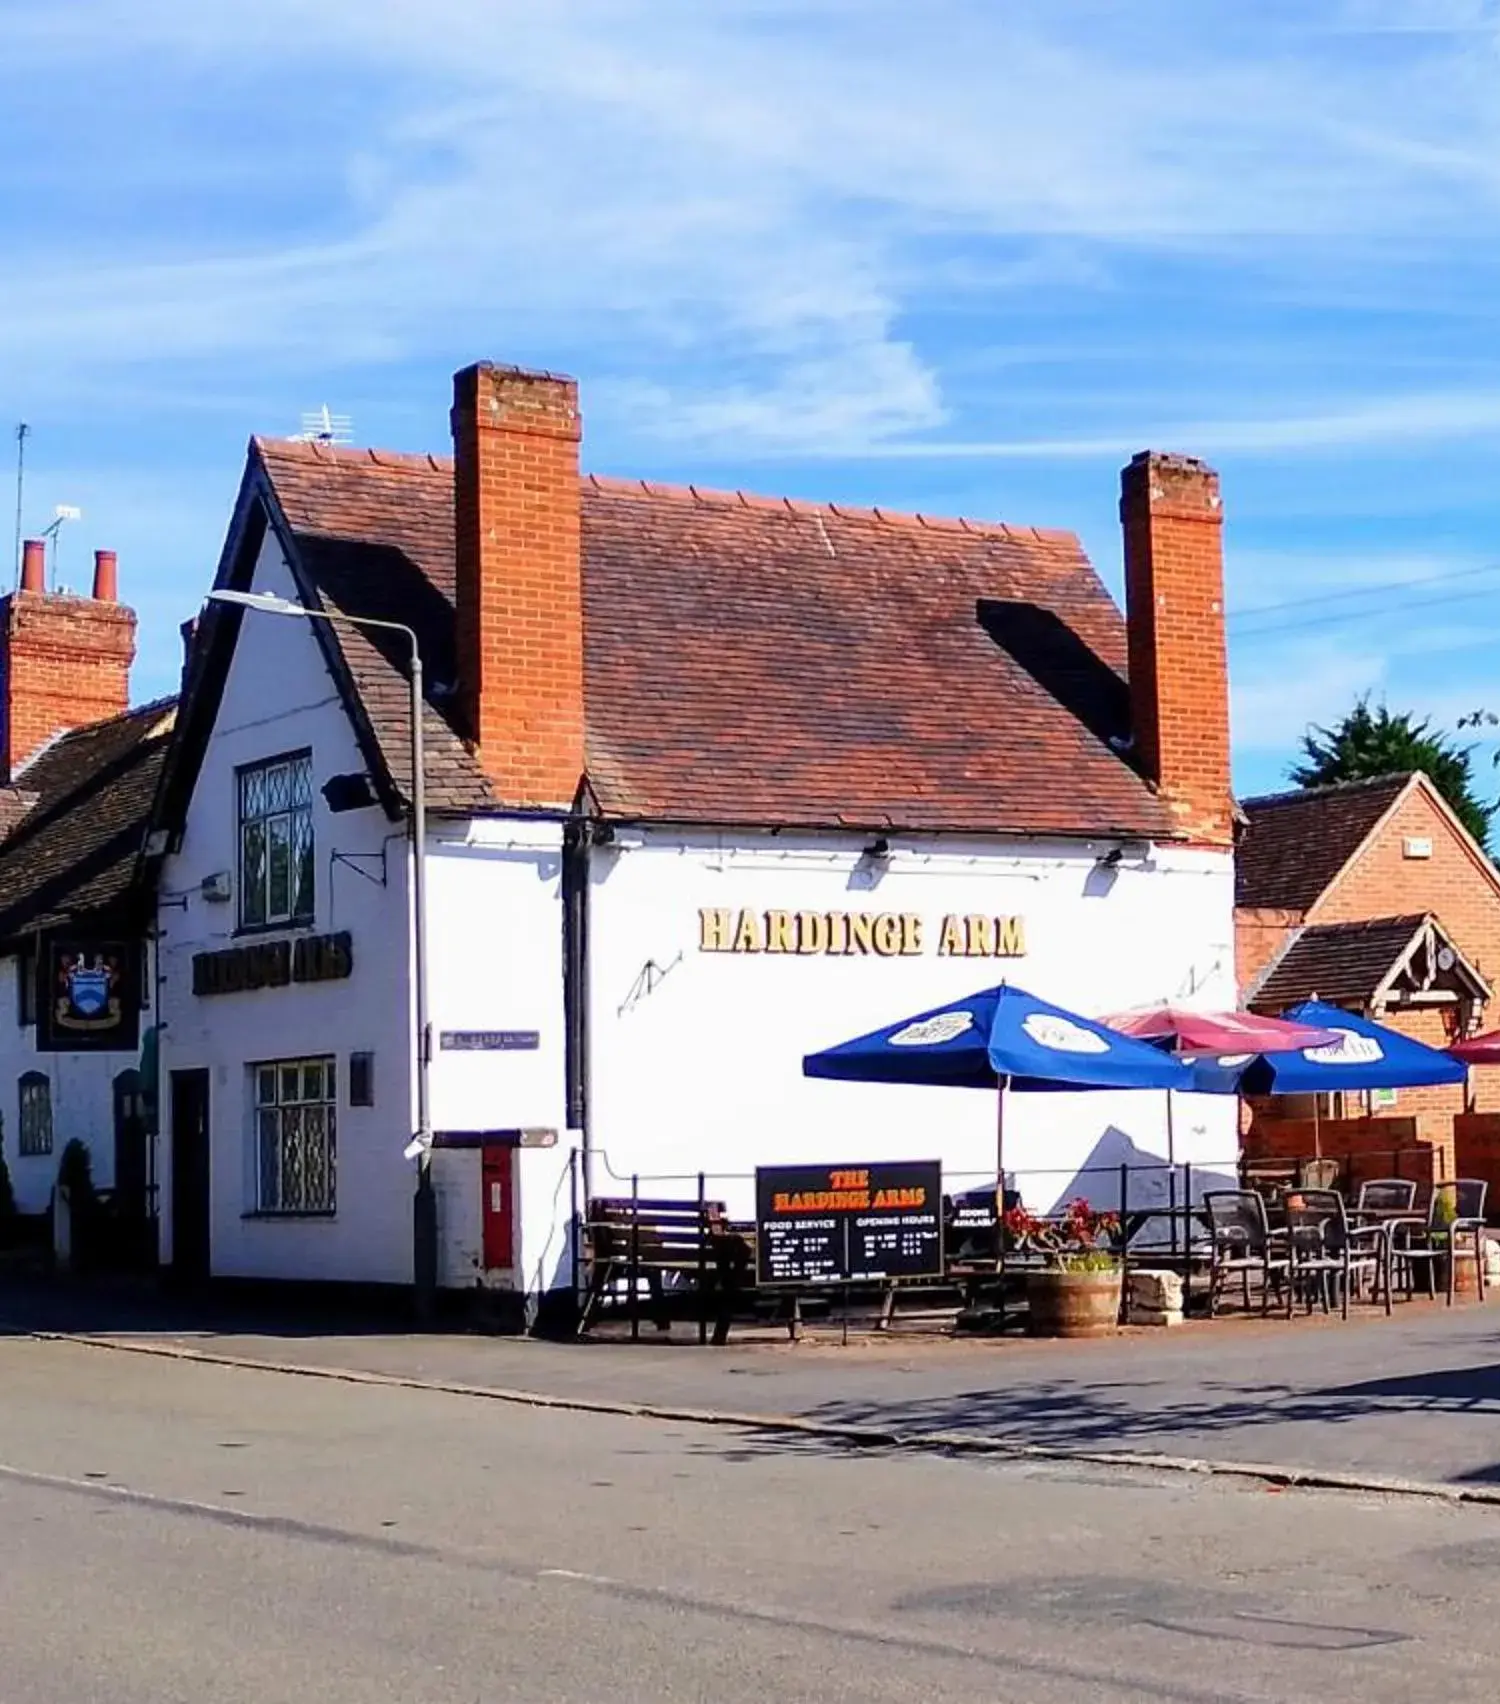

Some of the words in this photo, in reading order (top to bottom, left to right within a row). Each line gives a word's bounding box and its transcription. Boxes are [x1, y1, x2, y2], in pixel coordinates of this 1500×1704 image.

[698, 908, 923, 955] HARDINGE
[937, 913, 1028, 957] ARM
[830, 1170, 869, 1189] THE
[774, 1191, 870, 1212] HARDINGE
[871, 1187, 926, 1208] ARMS
[763, 1221, 793, 1230] FOOD
[794, 1219, 836, 1229] SERVICE
[856, 1217, 900, 1227] OPENING
[902, 1215, 935, 1225] HOURS
